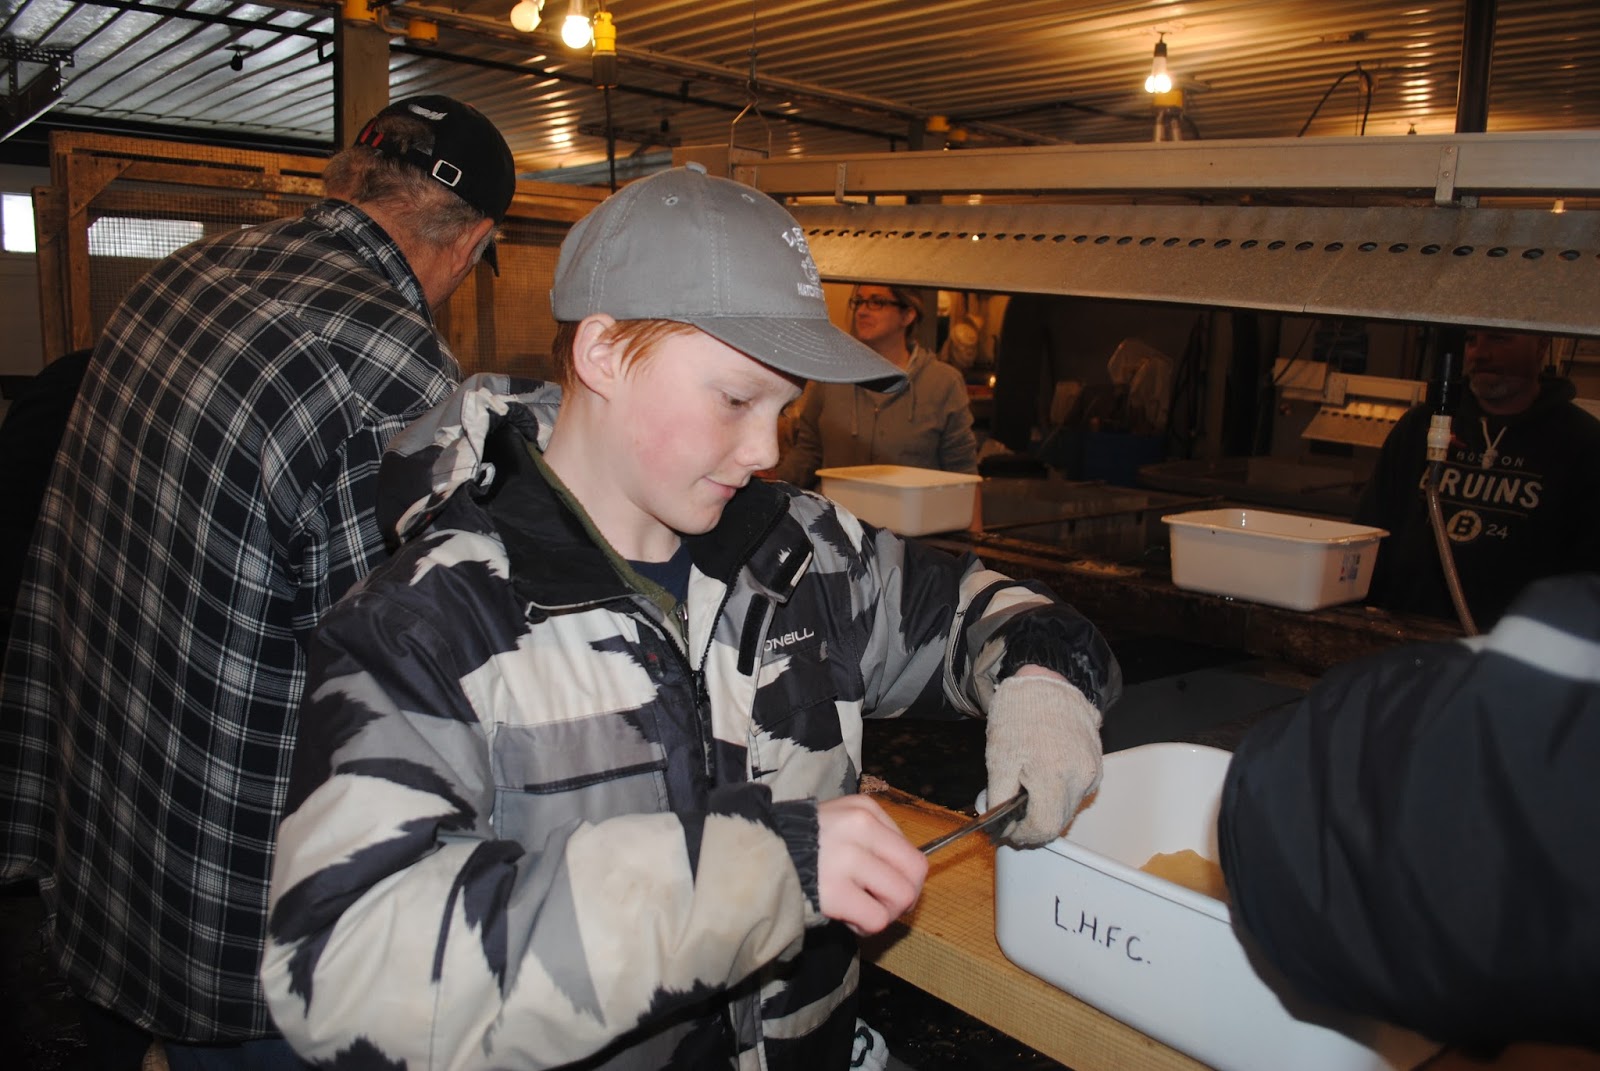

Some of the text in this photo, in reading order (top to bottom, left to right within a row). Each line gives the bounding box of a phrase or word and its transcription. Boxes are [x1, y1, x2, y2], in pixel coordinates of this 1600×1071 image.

[1456, 450, 1525, 467] BOSON
[1453, 514, 1509, 540] B 24
